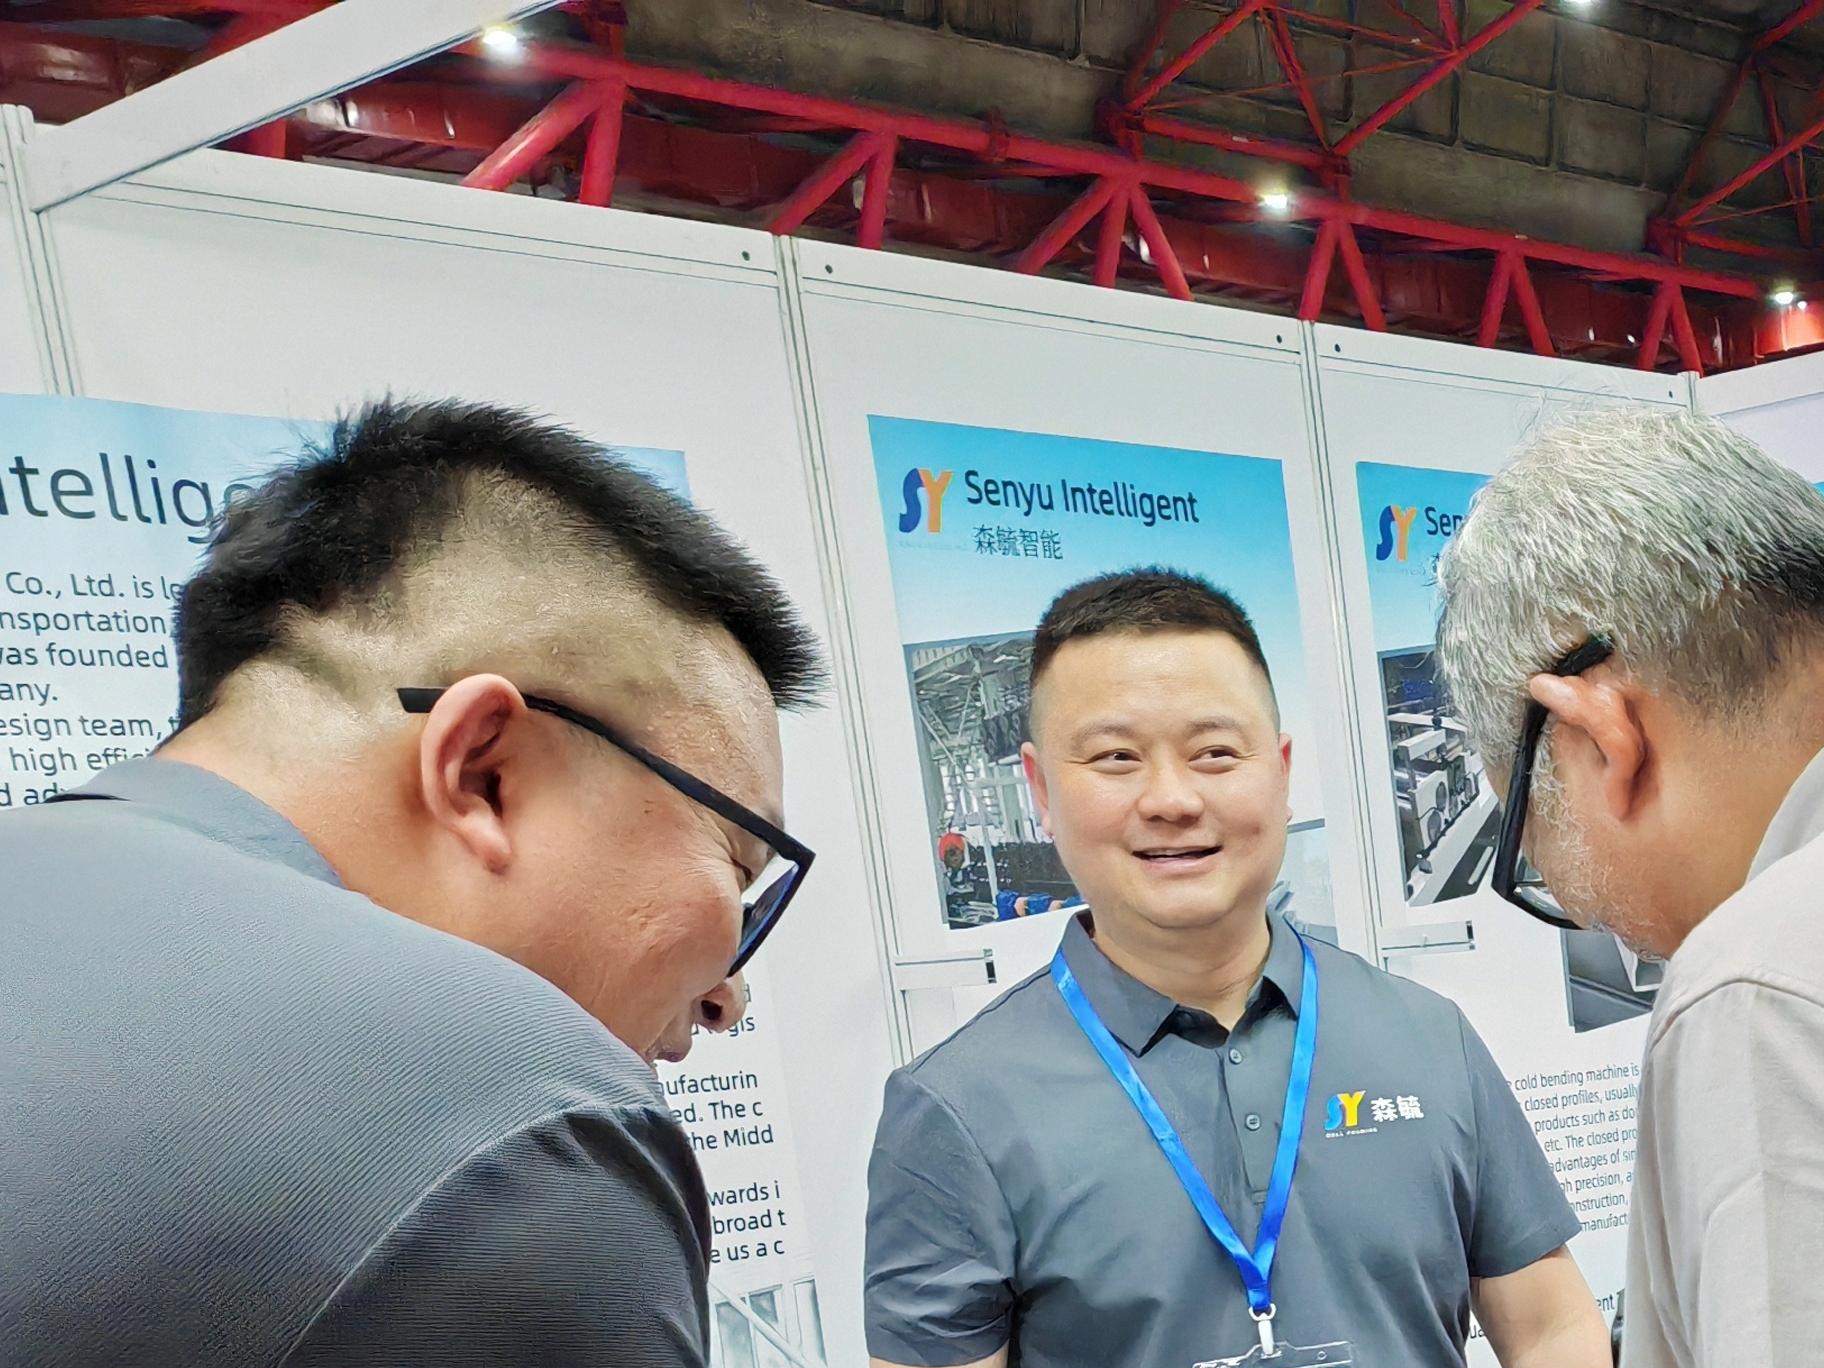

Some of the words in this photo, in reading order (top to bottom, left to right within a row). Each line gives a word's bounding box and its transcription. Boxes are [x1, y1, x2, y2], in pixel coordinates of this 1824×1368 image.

[965, 470, 1055, 517] Senyu
[1061, 479, 1199, 527] Intelligent
[1424, 506, 1464, 536] Sen
[973, 524, 1063, 560] 森毓智能
[6, 571, 62, 599] Co.,
[70, 573, 124, 597] Ltd.
[133, 575, 154, 599] is
[0, 609, 166, 635] nsportation
[46, 642, 168, 668] founded
[0, 682, 58, 706] any.
[79, 715, 162, 739] team,
[10, 747, 77, 775] high
[1515, 1075, 1537, 1090] cold
[1541, 1070, 1584, 1088] bending
[1587, 1064, 1629, 1081] machine
[708, 1100, 746, 1120] The
[753, 1101, 764, 1117] c
[1525, 1092, 1558, 1111] closed
[1562, 1090, 1602, 1110] profiles,
[1535, 1114, 1580, 1135] products
[1582, 1110, 1605, 1125] such
[1608, 1111, 1620, 1120] as
[1622, 1106, 1636, 1119] do
[690, 1132, 718, 1151] he
[724, 1124, 774, 1148] Midd
[1544, 1139, 1563, 1152] etc.
[1565, 1135, 1585, 1149] The
[1586, 1130, 1619, 1146] closed
[1611, 1149, 1621, 1163] of
[774, 1180, 780, 1198] i
[1575, 1173, 1623, 1193] precision,
[712, 1209, 772, 1235] broad
[777, 1209, 787, 1226] t
[727, 1245, 749, 1261] us
[756, 1243, 767, 1257] a
[774, 1240, 785, 1254] c
